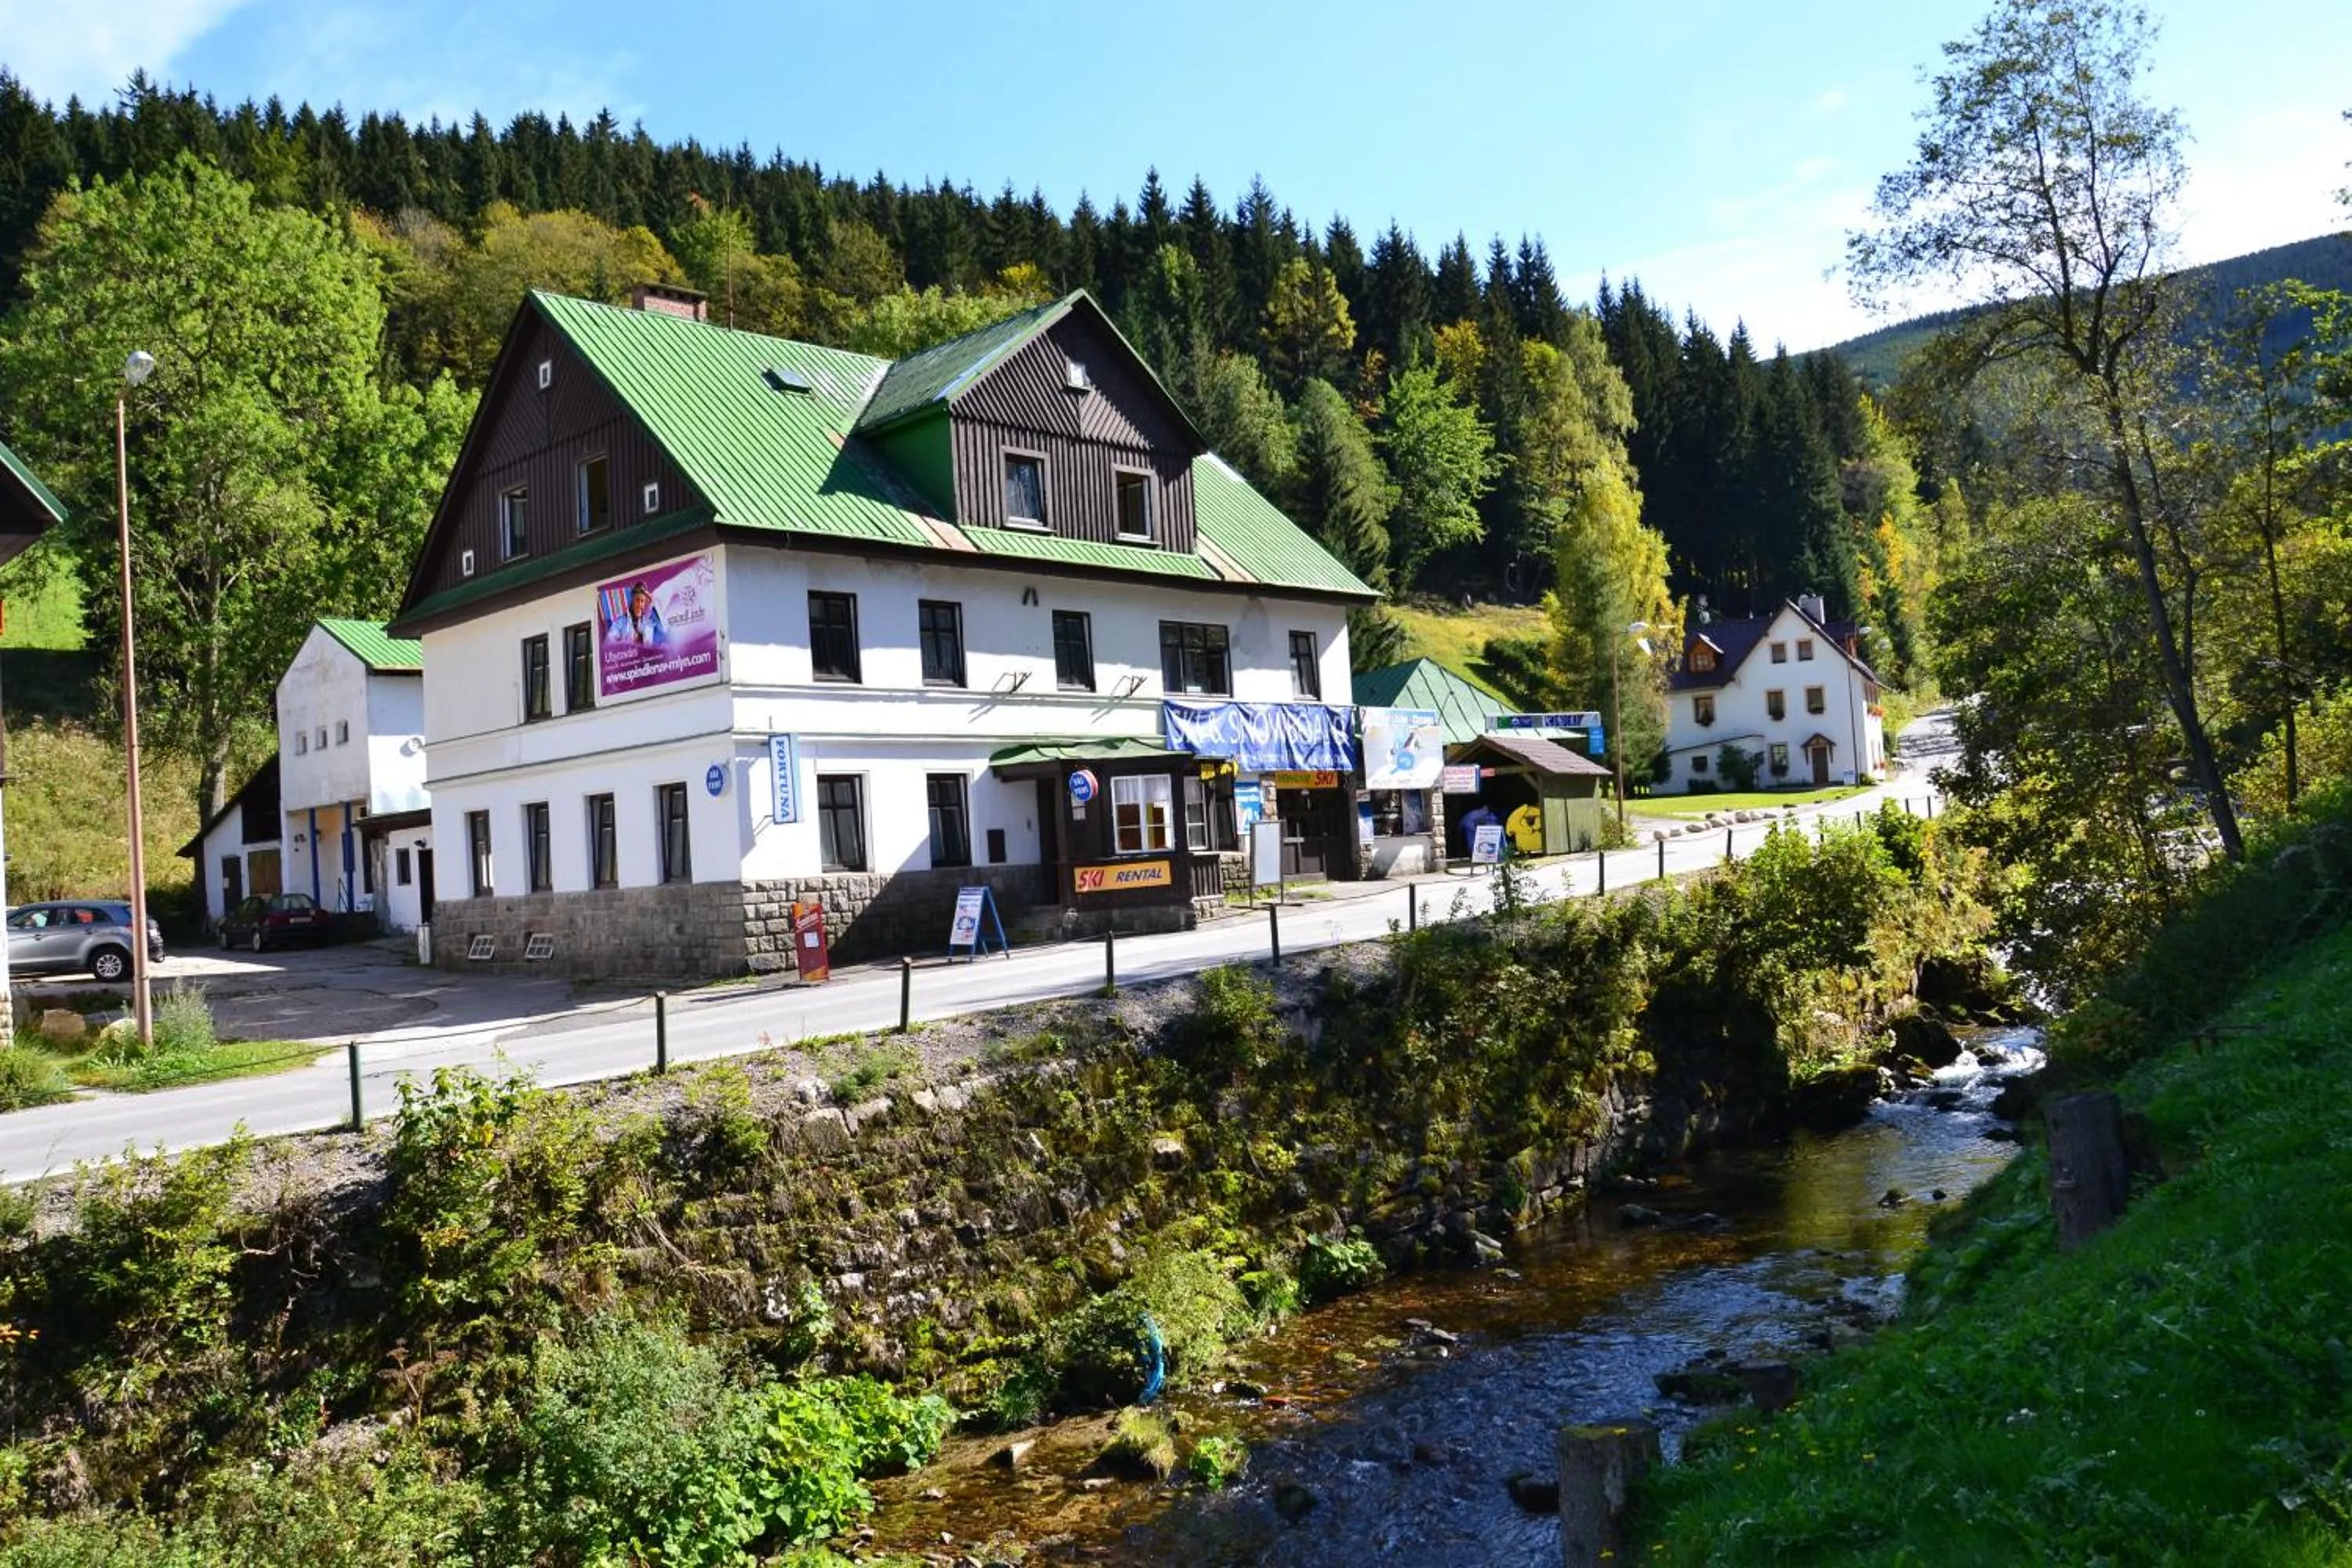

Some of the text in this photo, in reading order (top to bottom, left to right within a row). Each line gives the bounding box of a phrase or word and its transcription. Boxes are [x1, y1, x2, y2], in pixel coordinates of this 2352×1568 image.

[775, 739, 789, 818] FORTUNA
[1315, 770, 1334, 786] SKI
[1078, 867, 1163, 889] SKI RENTAL
